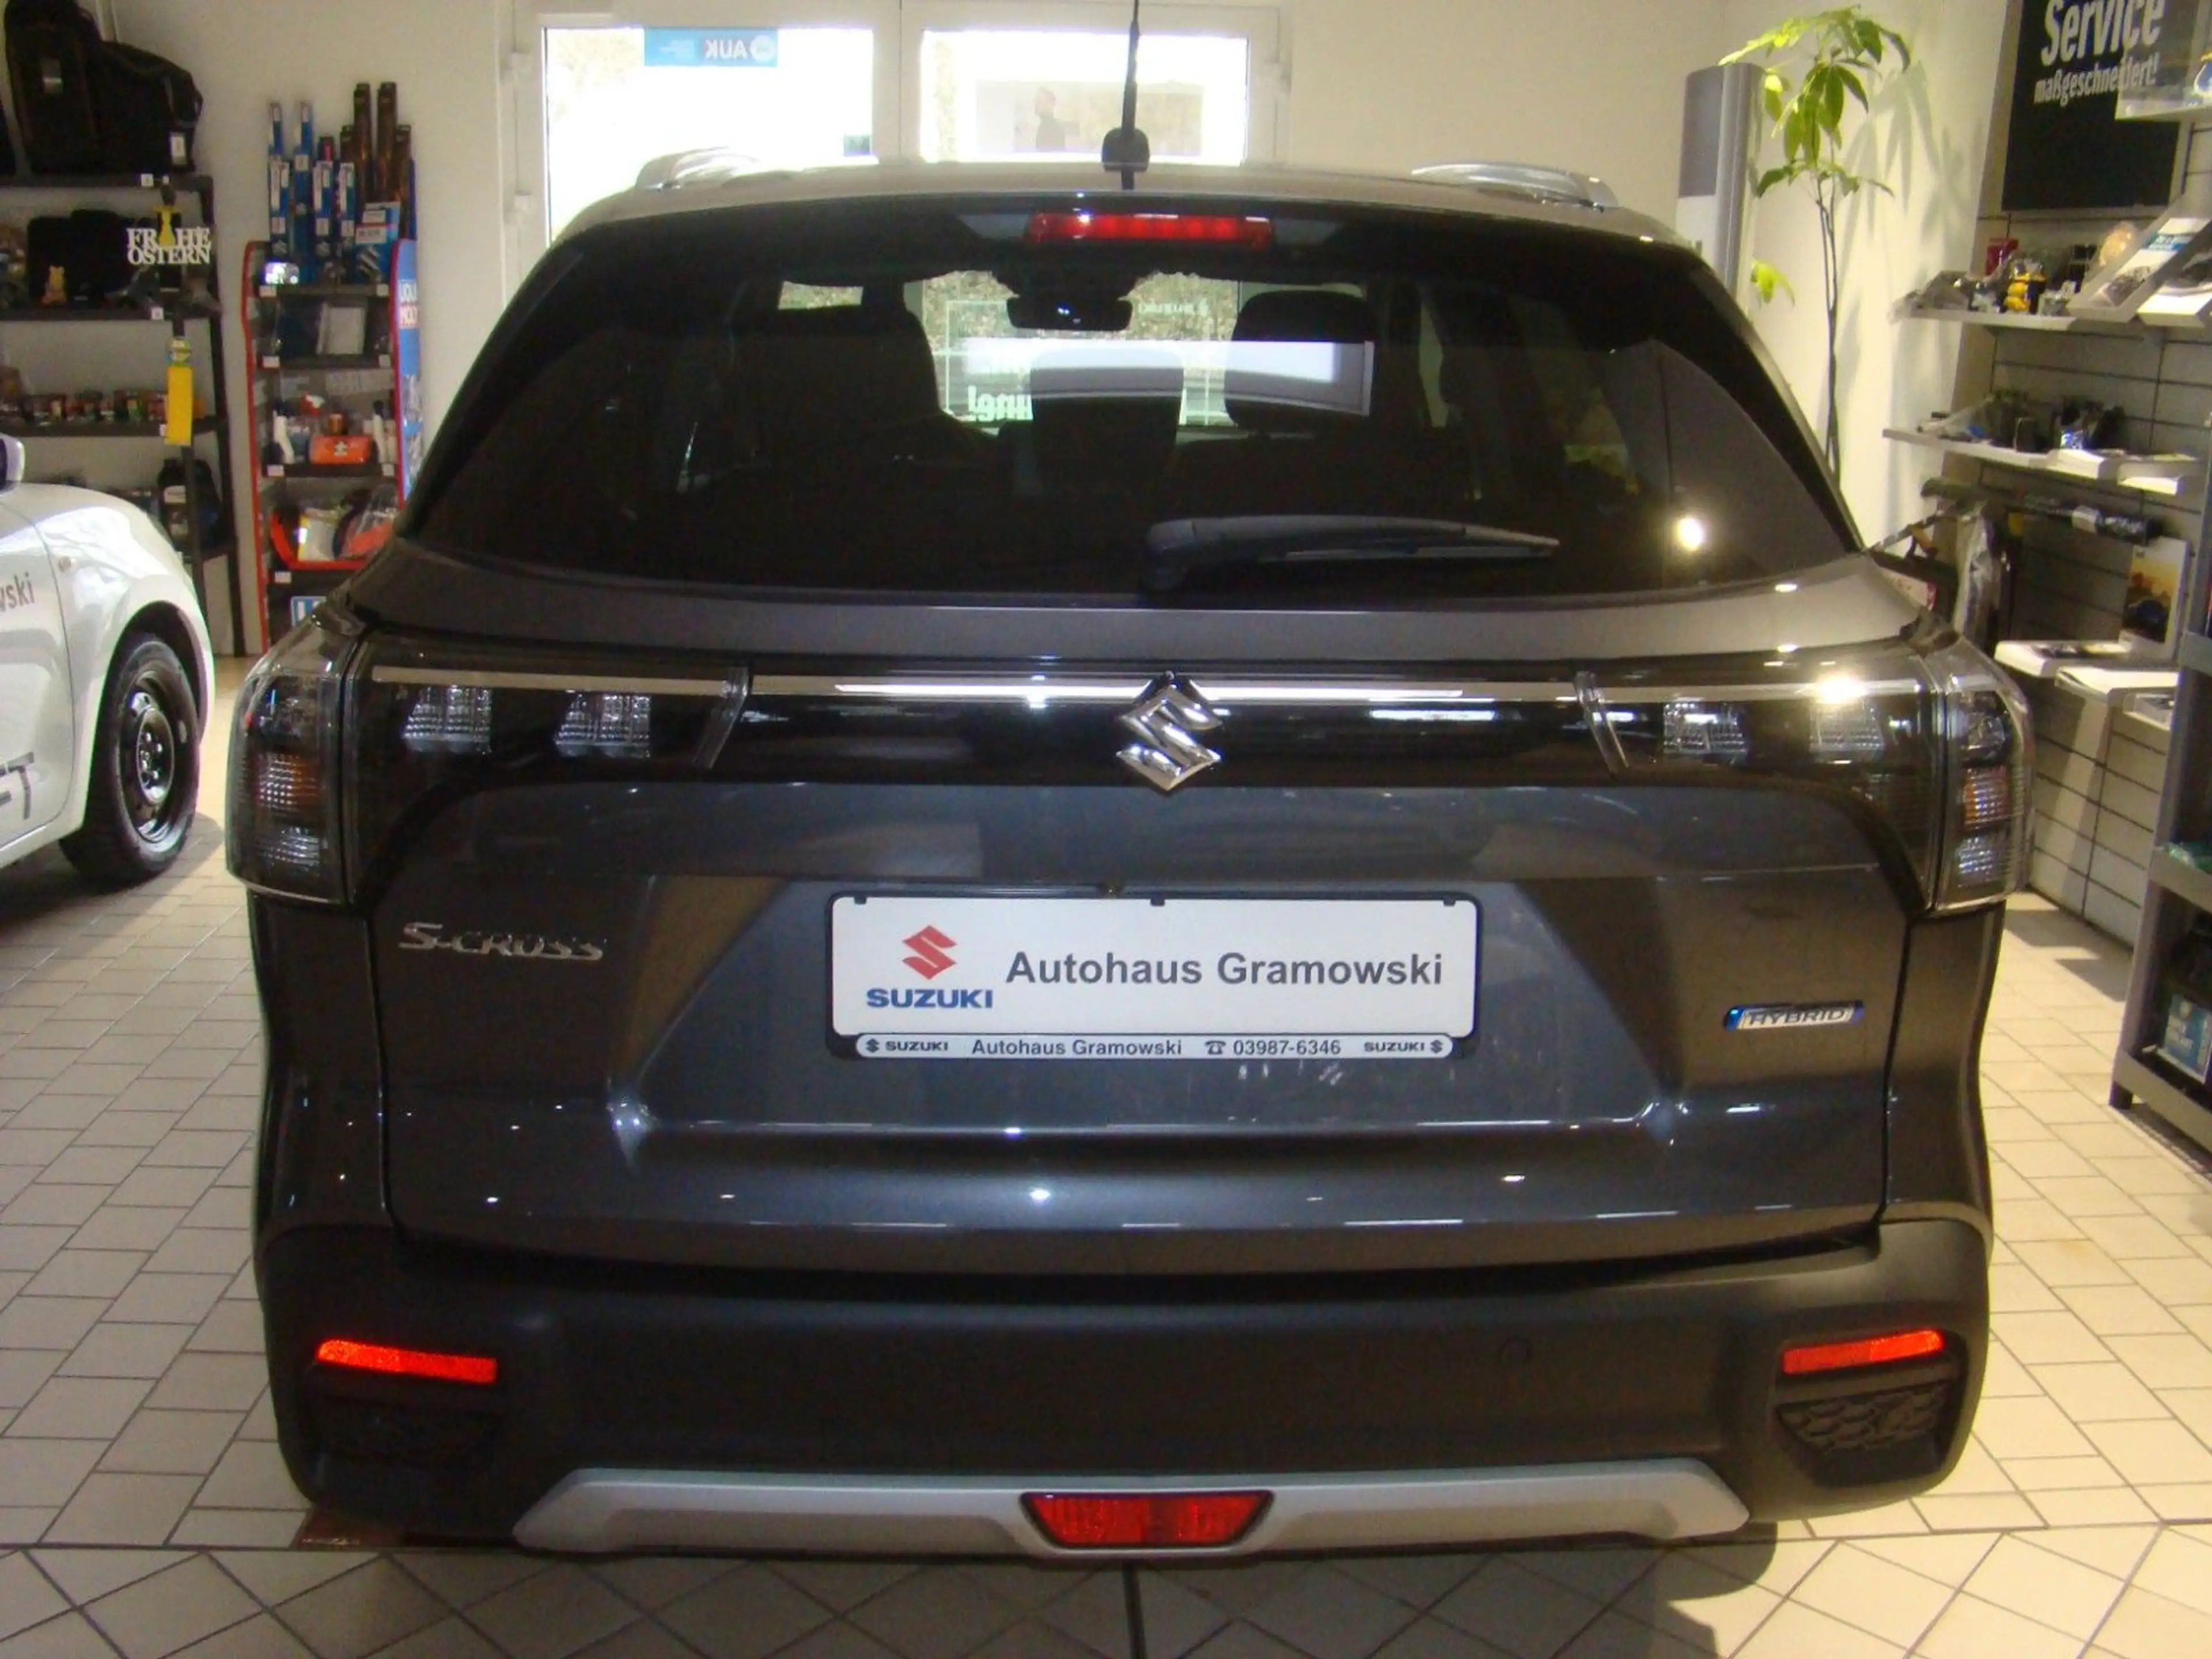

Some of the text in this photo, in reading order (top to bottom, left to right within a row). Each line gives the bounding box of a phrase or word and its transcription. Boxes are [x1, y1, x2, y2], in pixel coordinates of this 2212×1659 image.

[2040, 0, 2165, 66] Service
[126, 226, 211, 248] FRHE
[127, 245, 211, 265] OSTERN
[1006, 951, 1442, 985] Autohaus Gramowski
[866, 988, 993, 1009] SUZUKI
[885, 1039, 1425, 1056] SUZUKI Autohaus Gramowski 03987-6346 SUZUKI
